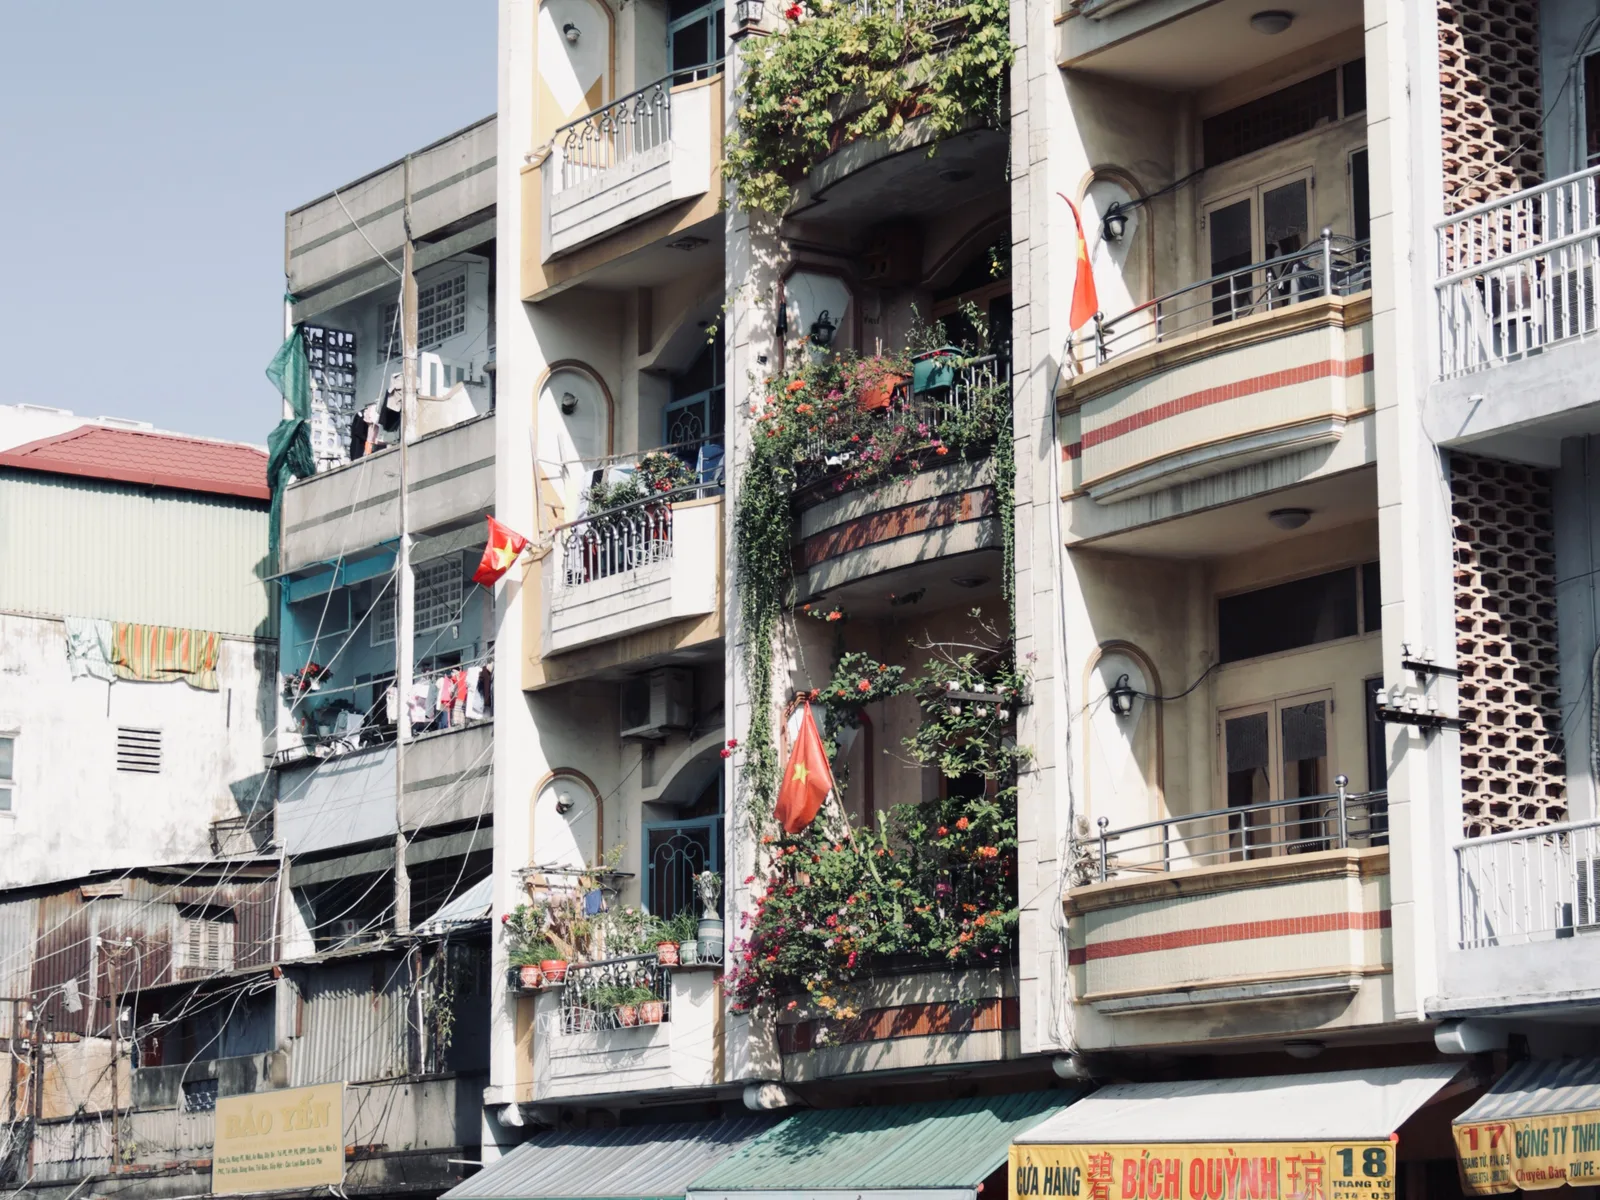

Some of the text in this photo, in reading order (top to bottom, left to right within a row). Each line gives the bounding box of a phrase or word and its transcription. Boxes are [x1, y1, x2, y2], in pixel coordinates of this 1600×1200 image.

[225, 1092, 331, 1139] BẢO YẾN
[1463, 1125, 1506, 1150] 17
[1515, 1123, 1549, 1159] CÔNG
[1552, 1126, 1568, 1155] TY
[1016, 1156, 1081, 1196] CỬA HÀNG
[1122, 1148, 1279, 1200] BÍCH QUỲNH
[1336, 1147, 1387, 1177] 18
[1515, 1168, 1546, 1184] Chuyên
[1583, 1161, 1594, 1176] PE
[1332, 1180, 1372, 1188] TRANG
